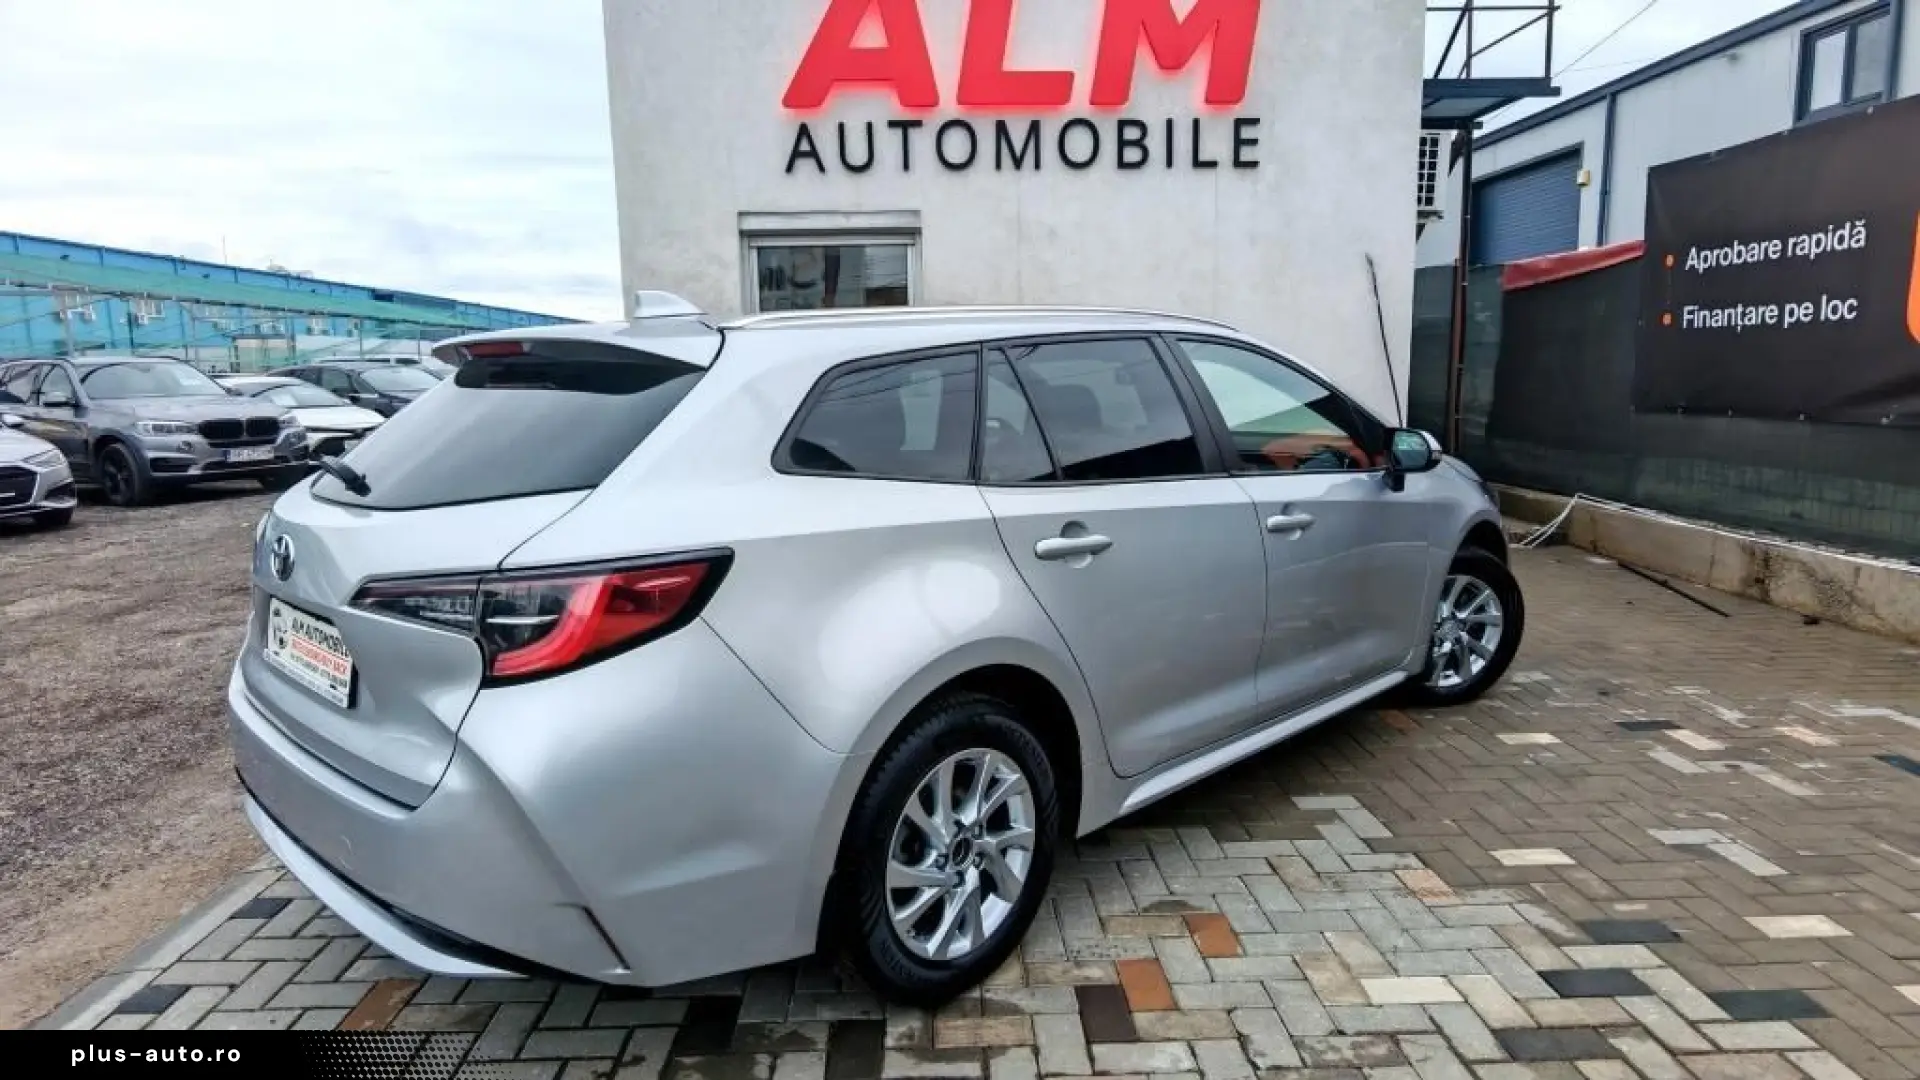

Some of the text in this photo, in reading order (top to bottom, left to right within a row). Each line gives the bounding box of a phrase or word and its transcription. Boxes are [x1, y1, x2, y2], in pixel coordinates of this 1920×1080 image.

[782, 0, 1261, 109] ALM
[785, 117, 1261, 174] AUTOMOBILE
[1685, 219, 1867, 273] Aprobare rapidă
[1683, 294, 1858, 333] Finanțare pe loc
